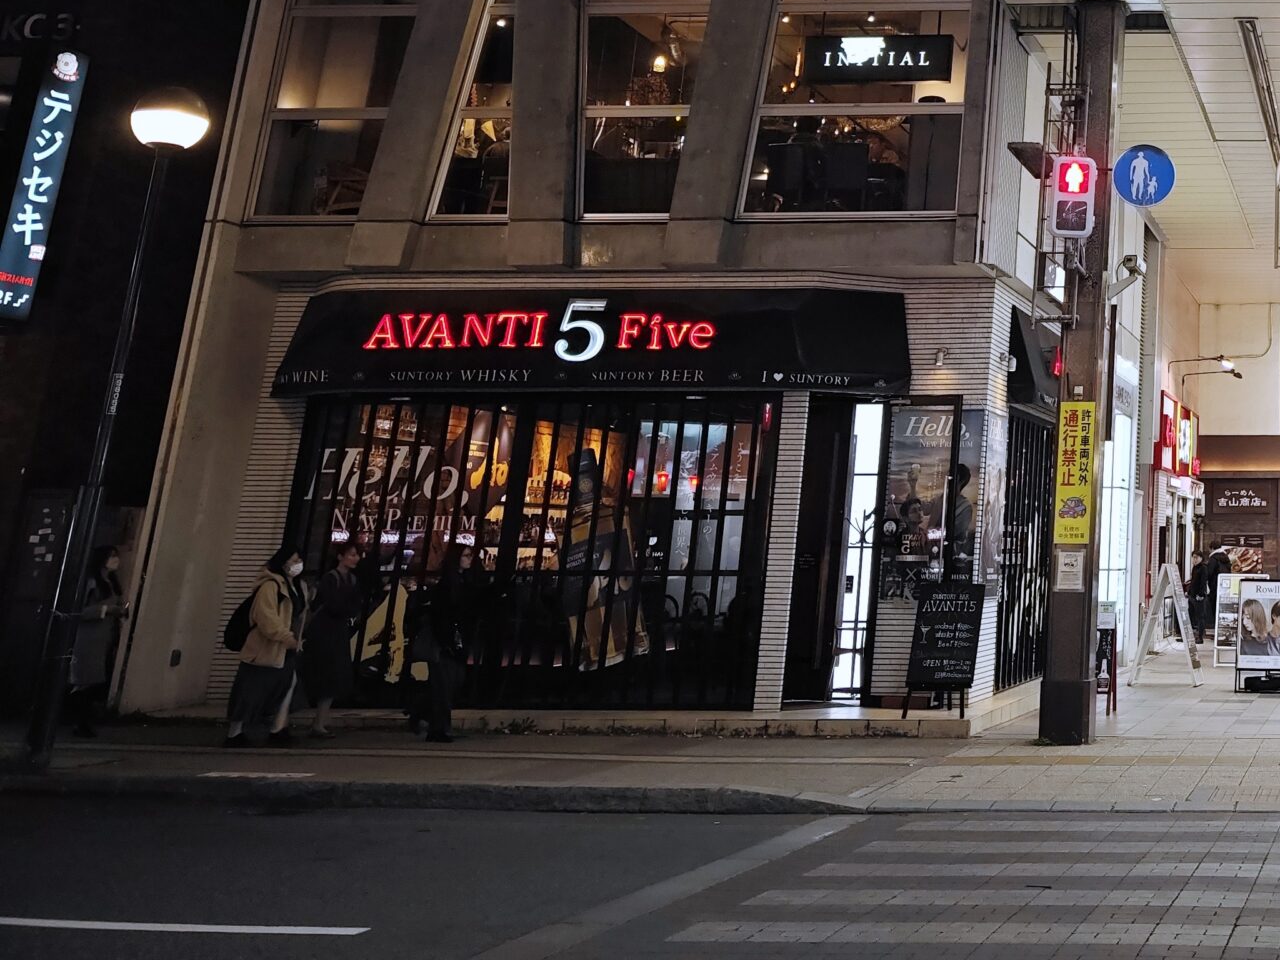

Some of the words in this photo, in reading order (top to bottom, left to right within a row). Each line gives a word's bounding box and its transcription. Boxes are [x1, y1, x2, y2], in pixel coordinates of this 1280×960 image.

[823, 50, 930, 67] INTIAL
[362, 312, 548, 350] AVANTI
[554, 298, 608, 362] 5
[616, 313, 717, 350] Five
[292, 369, 329, 383] WINE
[388, 370, 453, 382] SUNTORY
[460, 369, 533, 382] WHISKY
[591, 370, 655, 382] SUNTORY
[661, 369, 705, 383] BEER
[788, 373, 851, 386] SUNTORY
[1060, 409, 1080, 487] 通行禁止
[1077, 409, 1092, 486] 許可車両以外
[1217, 497, 1262, 507] 吉山商店
[332, 508, 377, 530] NW
